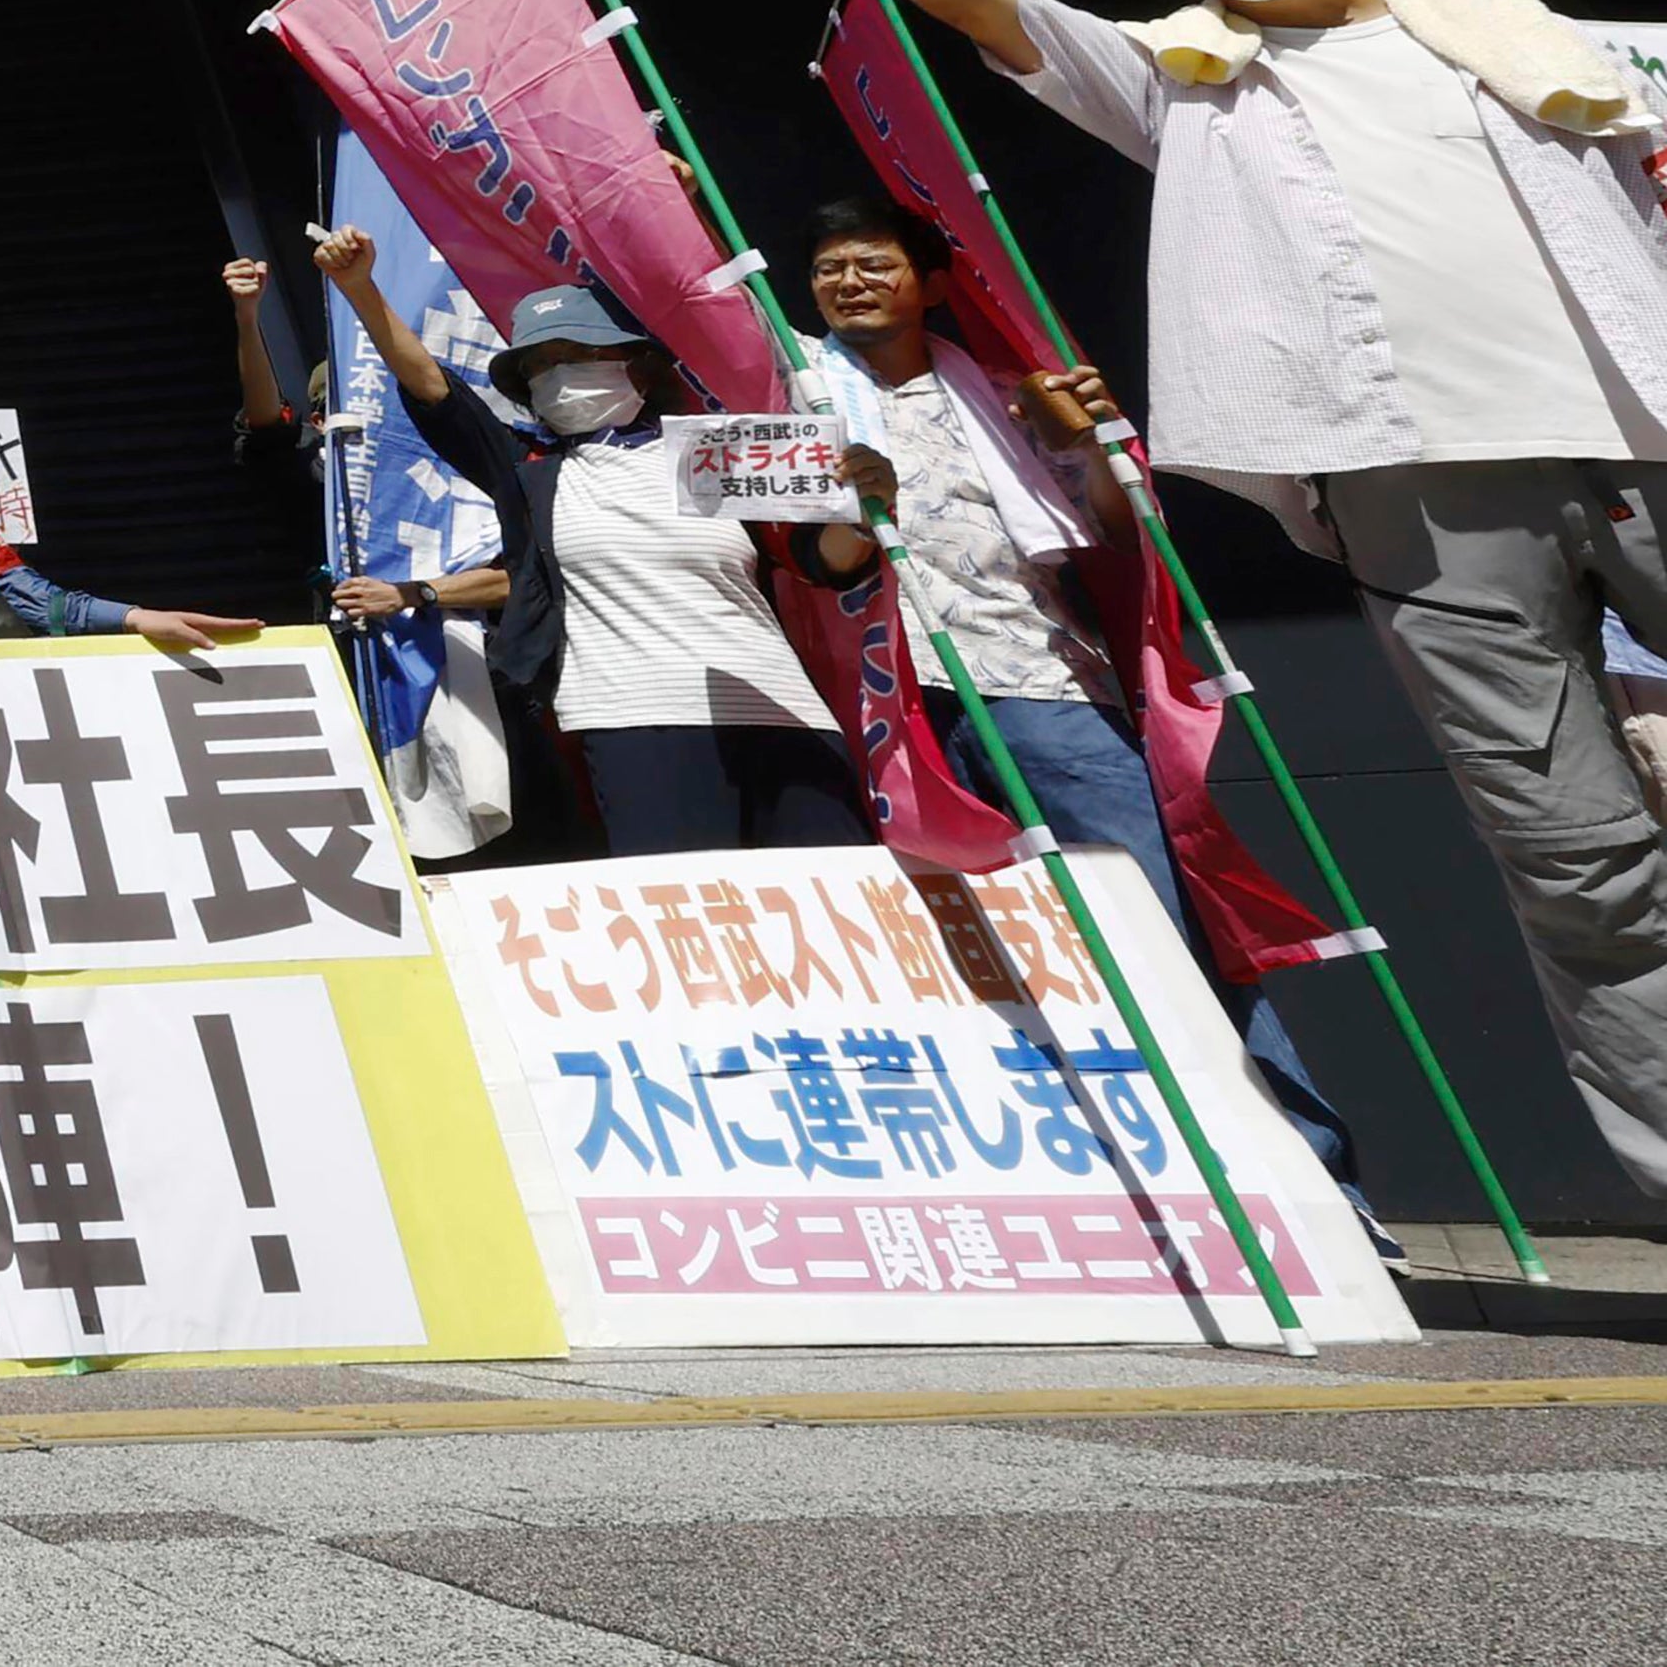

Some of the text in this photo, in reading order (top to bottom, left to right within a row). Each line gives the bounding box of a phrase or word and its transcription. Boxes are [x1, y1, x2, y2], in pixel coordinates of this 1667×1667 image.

[692, 440, 834, 475] ストライキ
